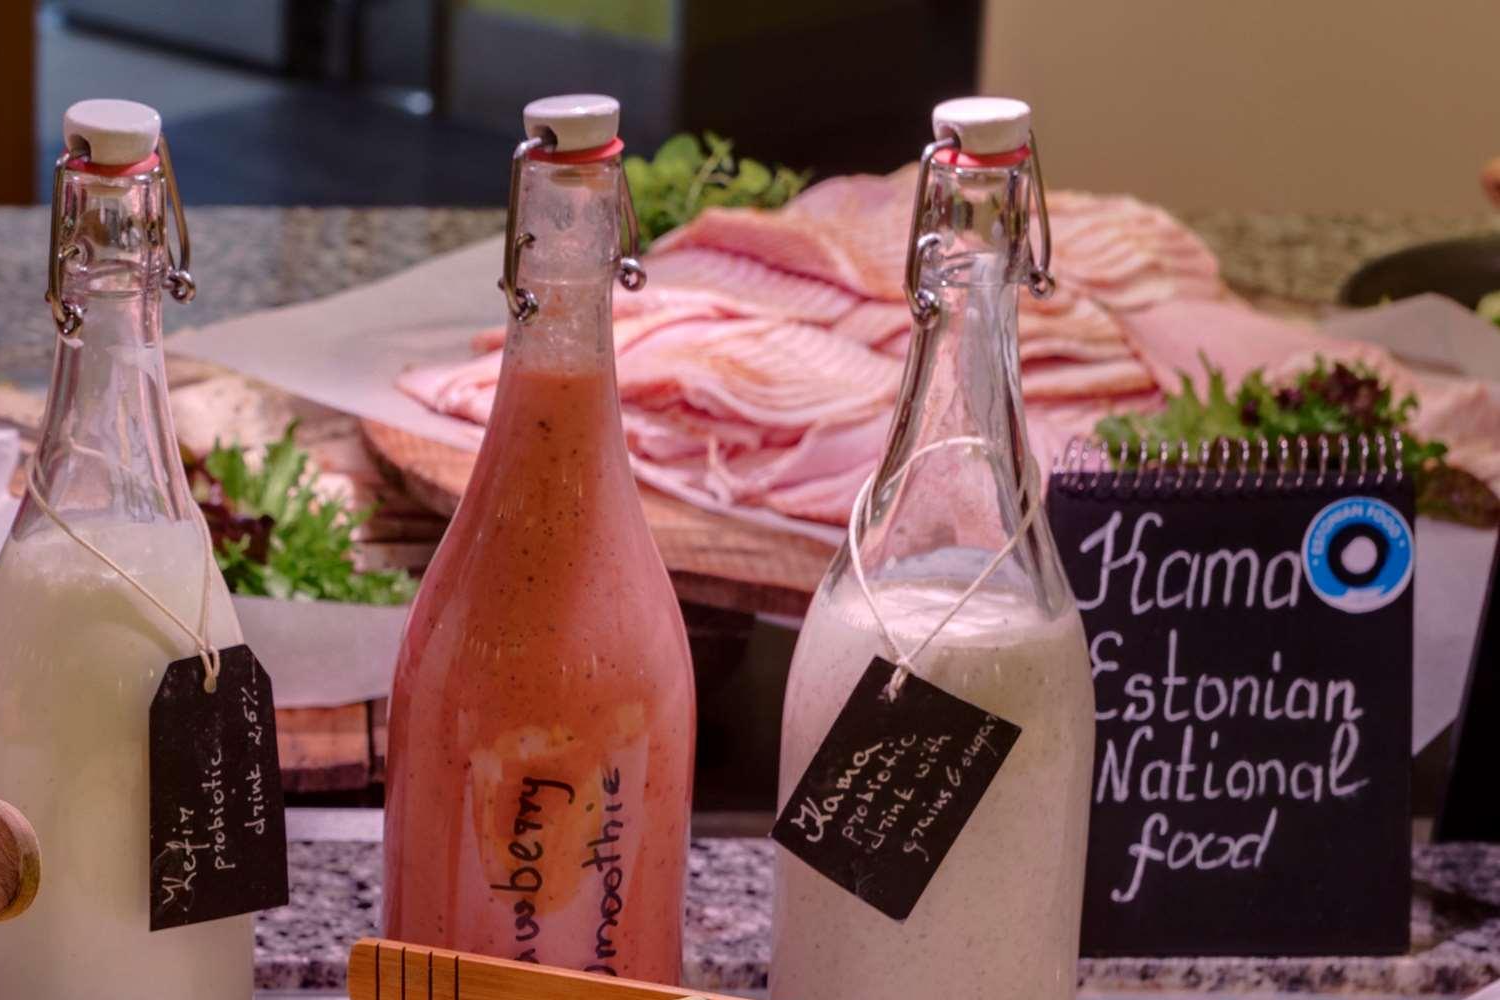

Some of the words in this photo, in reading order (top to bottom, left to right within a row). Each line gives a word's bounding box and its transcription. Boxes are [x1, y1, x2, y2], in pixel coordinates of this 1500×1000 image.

[1076, 510, 1301, 615] Kama
[1366, 504, 1401, 539] FOOD
[1090, 629, 1365, 723] Estonian
[201, 748, 236, 871] probiotic
[244, 763, 266, 835] drink
[790, 741, 884, 843] Kama
[841, 733, 917, 846] probiotic
[863, 787, 915, 849] drink
[915, 734, 952, 779] with
[1096, 721, 1371, 803] National
[161, 806, 211, 905] Kefir
[902, 789, 953, 862] grains
[1110, 806, 1278, 903] food
